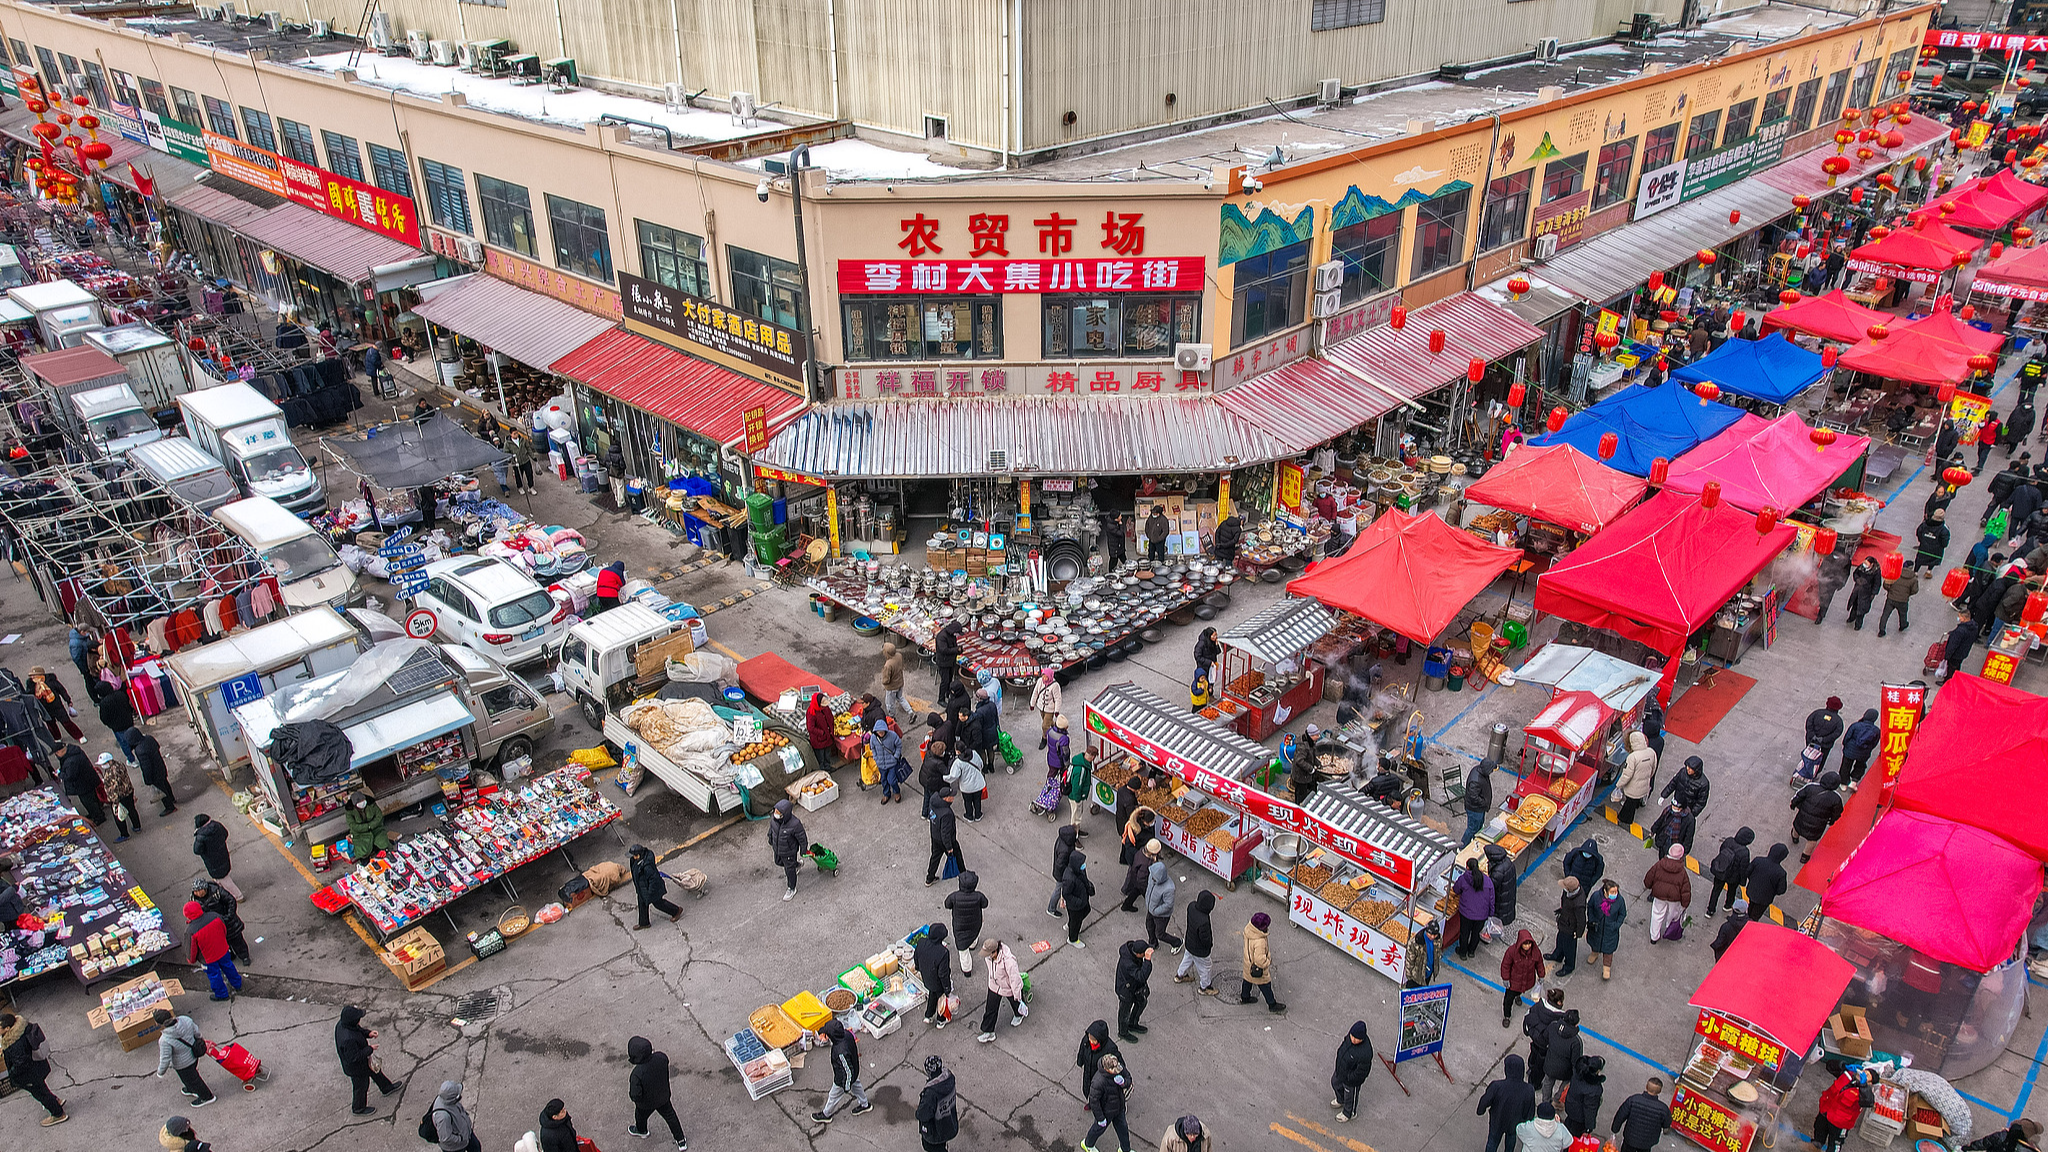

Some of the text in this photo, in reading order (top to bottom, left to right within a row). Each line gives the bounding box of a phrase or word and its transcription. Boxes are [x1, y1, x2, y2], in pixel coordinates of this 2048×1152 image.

[898, 211, 1147, 258] 农贸市场
[865, 261, 1179, 291] 李村大集小吃街
[682, 297, 793, 355] 大付家酒店用品
[1085, 306, 1107, 351] 家电
[875, 369, 1007, 393] 祥福开锁
[1045, 371, 1208, 393] 精品厨具
[744, 407, 765, 423] 配钥匙
[748, 419, 764, 435] 开锁
[749, 431, 765, 446] 换锁
[413, 618, 432, 630] 5km
[231, 680, 245, 699] P
[1887, 690, 1920, 704] 桂林
[1267, 803, 1398, 874] 现炸现卖
[1293, 894, 1403, 973] 现炸现卖
[1701, 1016, 1780, 1064] 小霞糖球
[1671, 1106, 1742, 1152] 就是这个味
[1683, 1097, 1741, 1136] 小霞糖球
